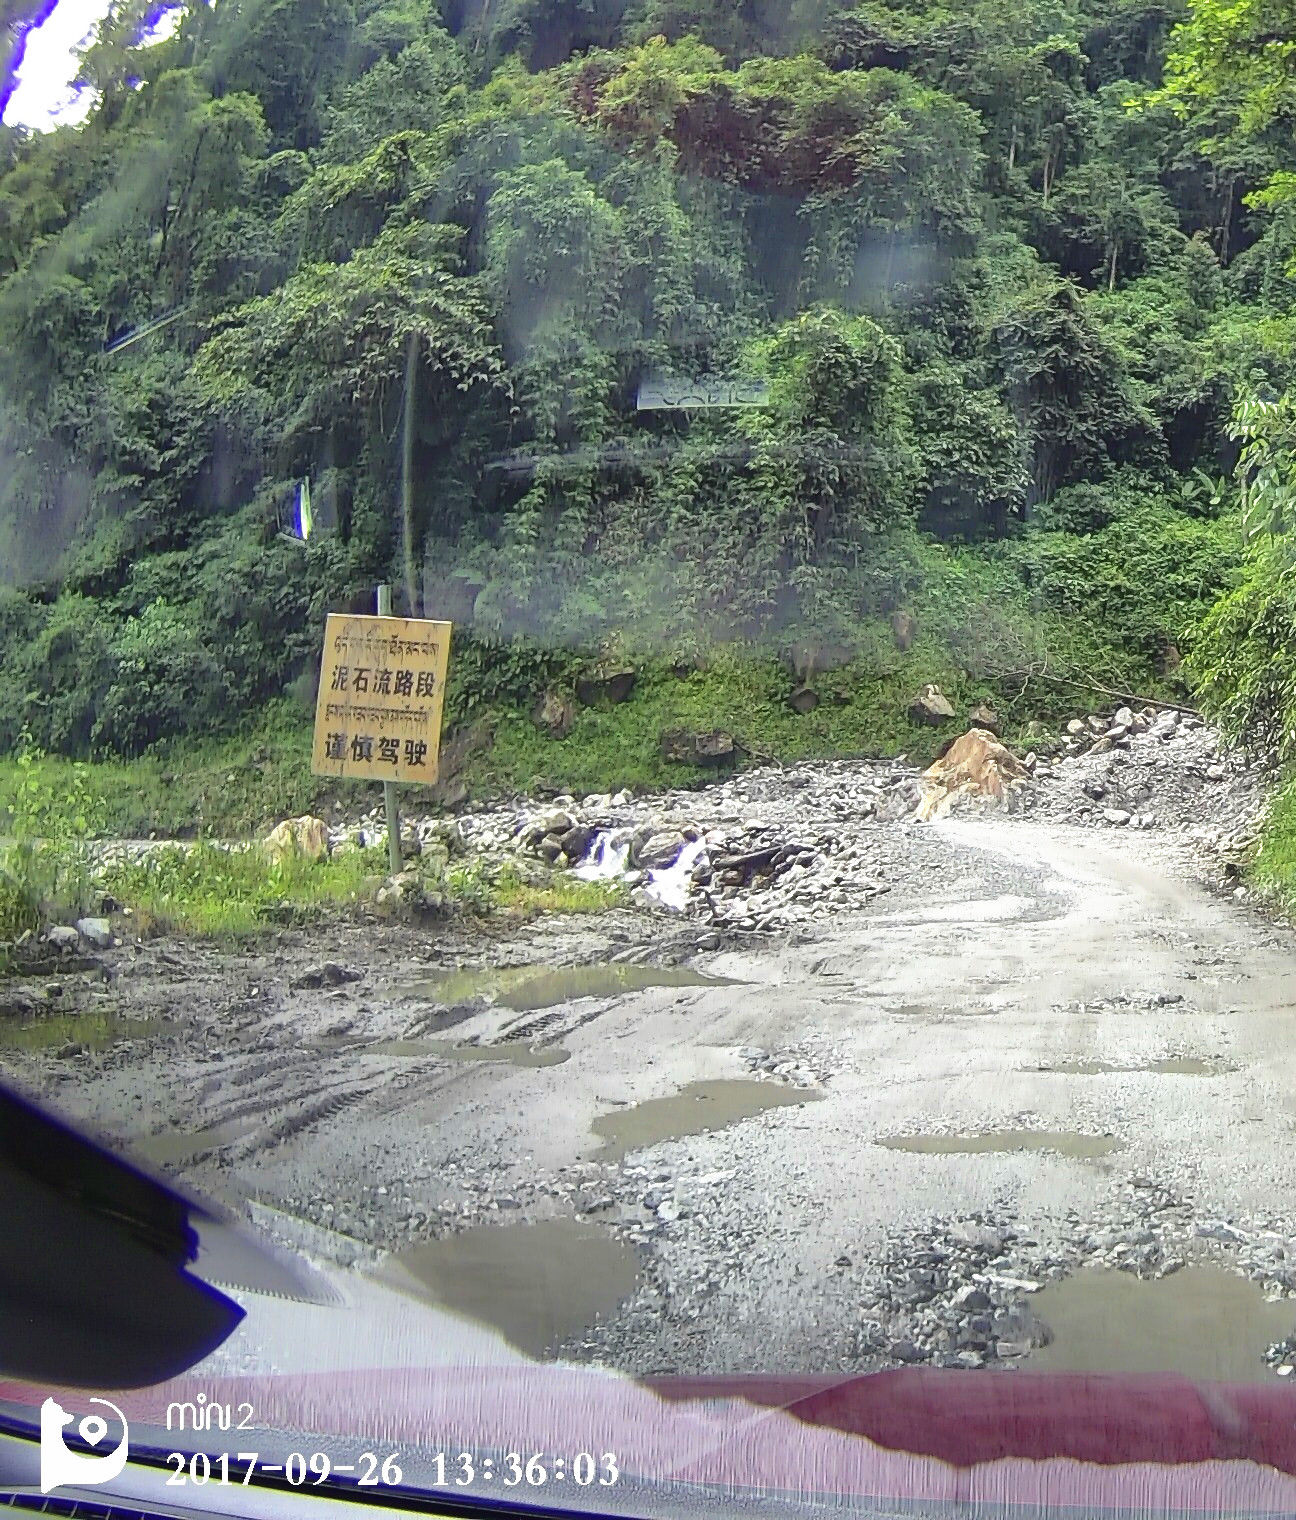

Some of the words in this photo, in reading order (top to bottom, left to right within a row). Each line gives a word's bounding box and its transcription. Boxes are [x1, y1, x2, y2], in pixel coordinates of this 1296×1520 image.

[331, 665, 436, 698] 泥石流路段
[325, 732, 428, 767] 谨慎驾驶
